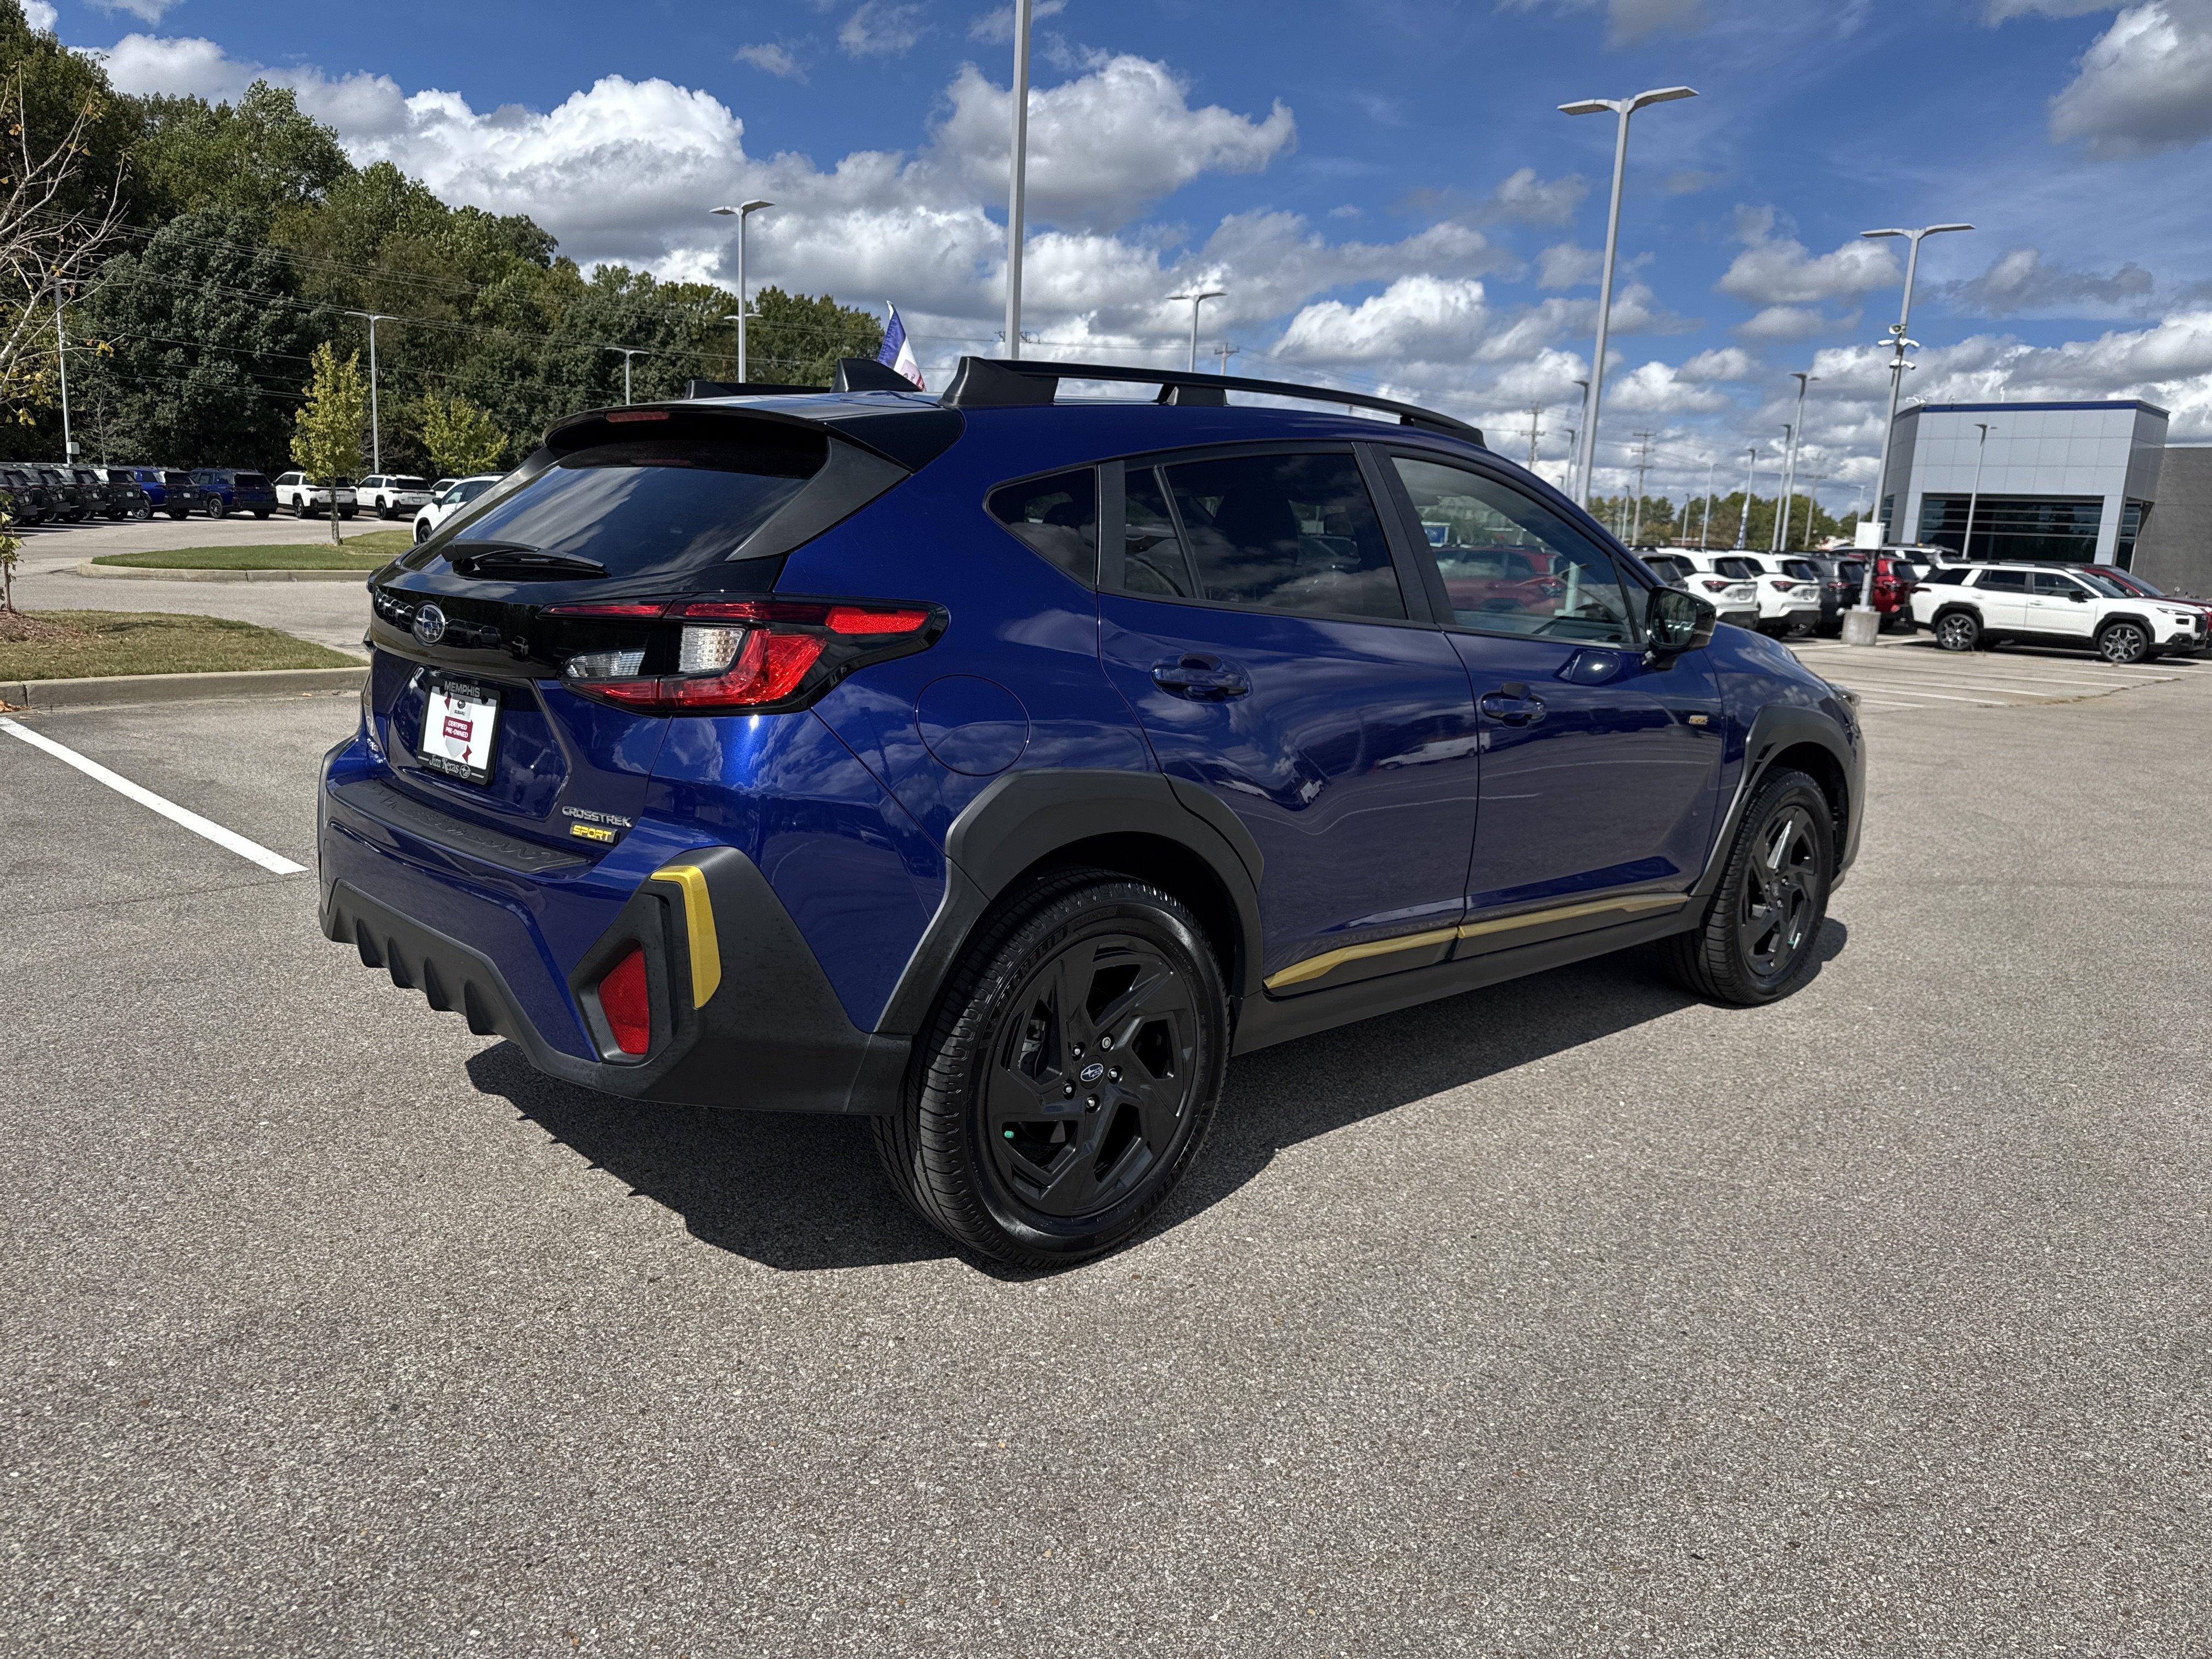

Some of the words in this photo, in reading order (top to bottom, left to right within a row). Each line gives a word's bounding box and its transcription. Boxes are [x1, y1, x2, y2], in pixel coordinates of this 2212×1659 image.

[444, 680, 481, 697] MEMPHIS
[445, 726, 469, 738] PRE-OWNED
[448, 720, 467, 731] CERTIFIED
[429, 754, 442, 768] Jim
[442, 758, 459, 774] Keras
[562, 806, 633, 827] CROSSTREK
[573, 825, 612, 841] SPORT
[994, 927, 1066, 1014] MICHELIN
